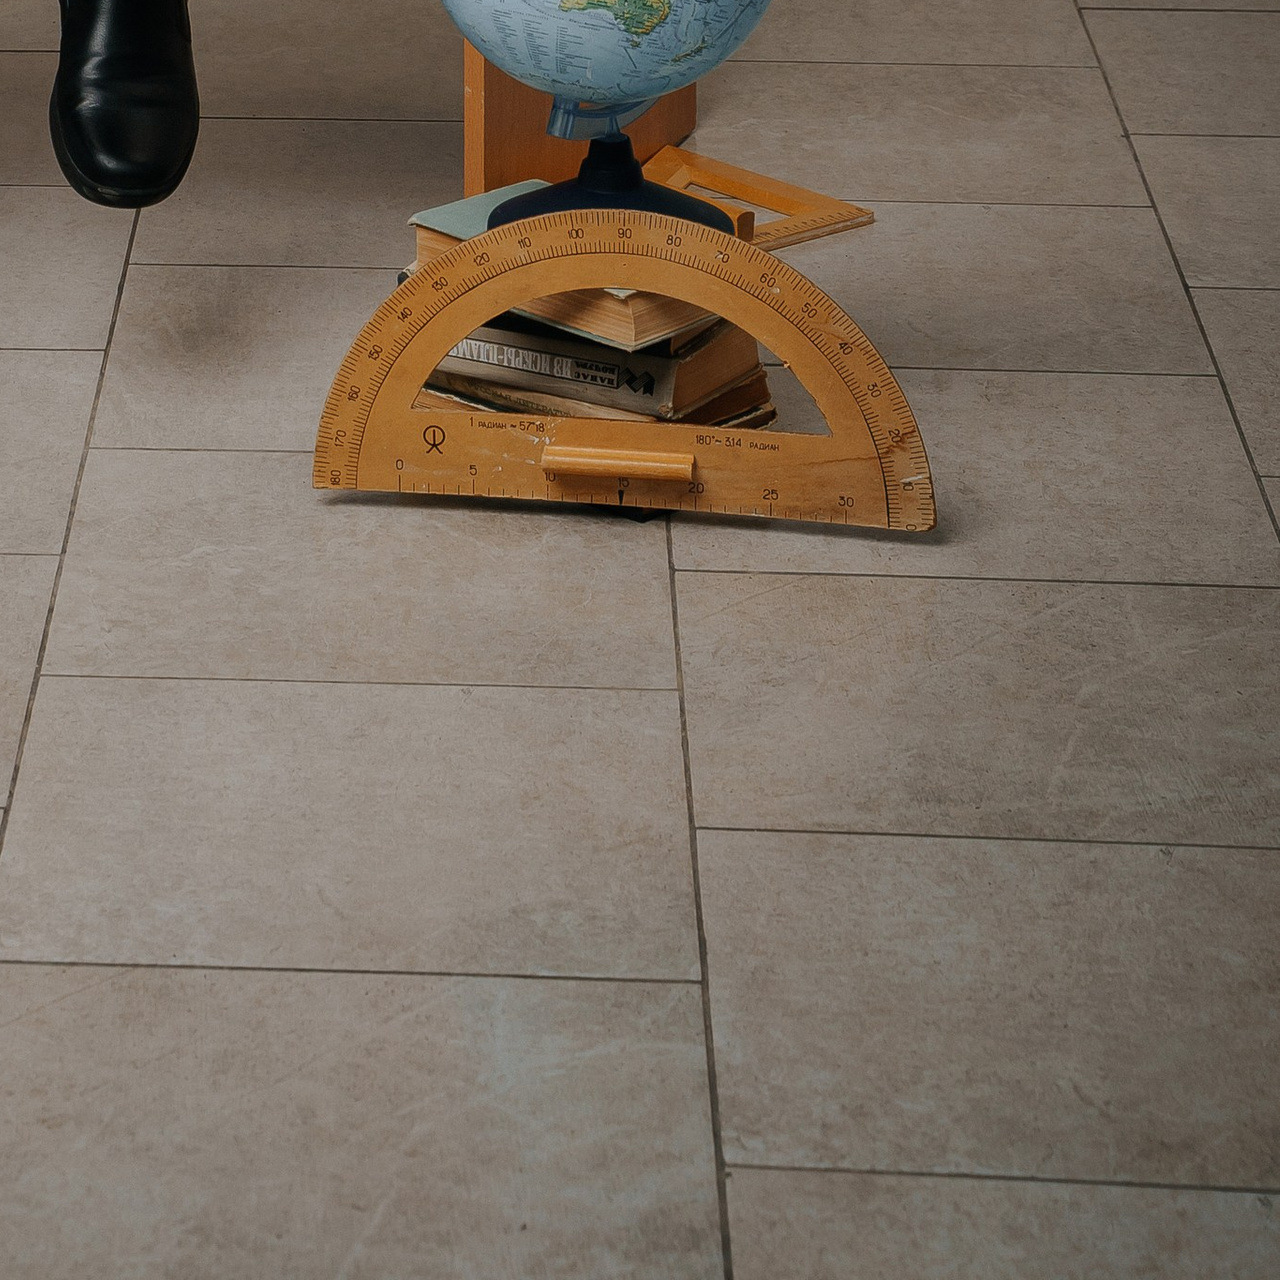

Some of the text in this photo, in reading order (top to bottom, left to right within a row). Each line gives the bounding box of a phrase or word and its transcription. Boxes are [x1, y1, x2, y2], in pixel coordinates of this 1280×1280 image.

[567, 228, 584, 239] 100
[617, 228, 632, 239] 90
[666, 234, 682, 247] 80
[518, 236, 532, 249] 110
[473, 252, 490, 267] 120
[714, 250, 730, 264] 70
[431, 276, 449, 292] 130
[759, 272, 776, 288] 60
[397, 306, 413, 323] 140
[801, 302, 818, 319] 50
[368, 344, 383, 361] 150
[838, 341, 854, 356] 40
[347, 385, 361, 402] 160
[867, 382, 882, 398] 30
[478, 421, 507, 430] РАДИАН
[334, 429, 347, 448] 170
[888, 428, 902, 443] 20
[749, 442, 780, 451] РАДИАН
[330, 469, 342, 486] 180
[396, 459, 404, 470] 0
[470, 465, 477, 475] 5
[688, 482, 705, 494] 20
[762, 488, 779, 501] 25
[837, 496, 854, 508] 30
